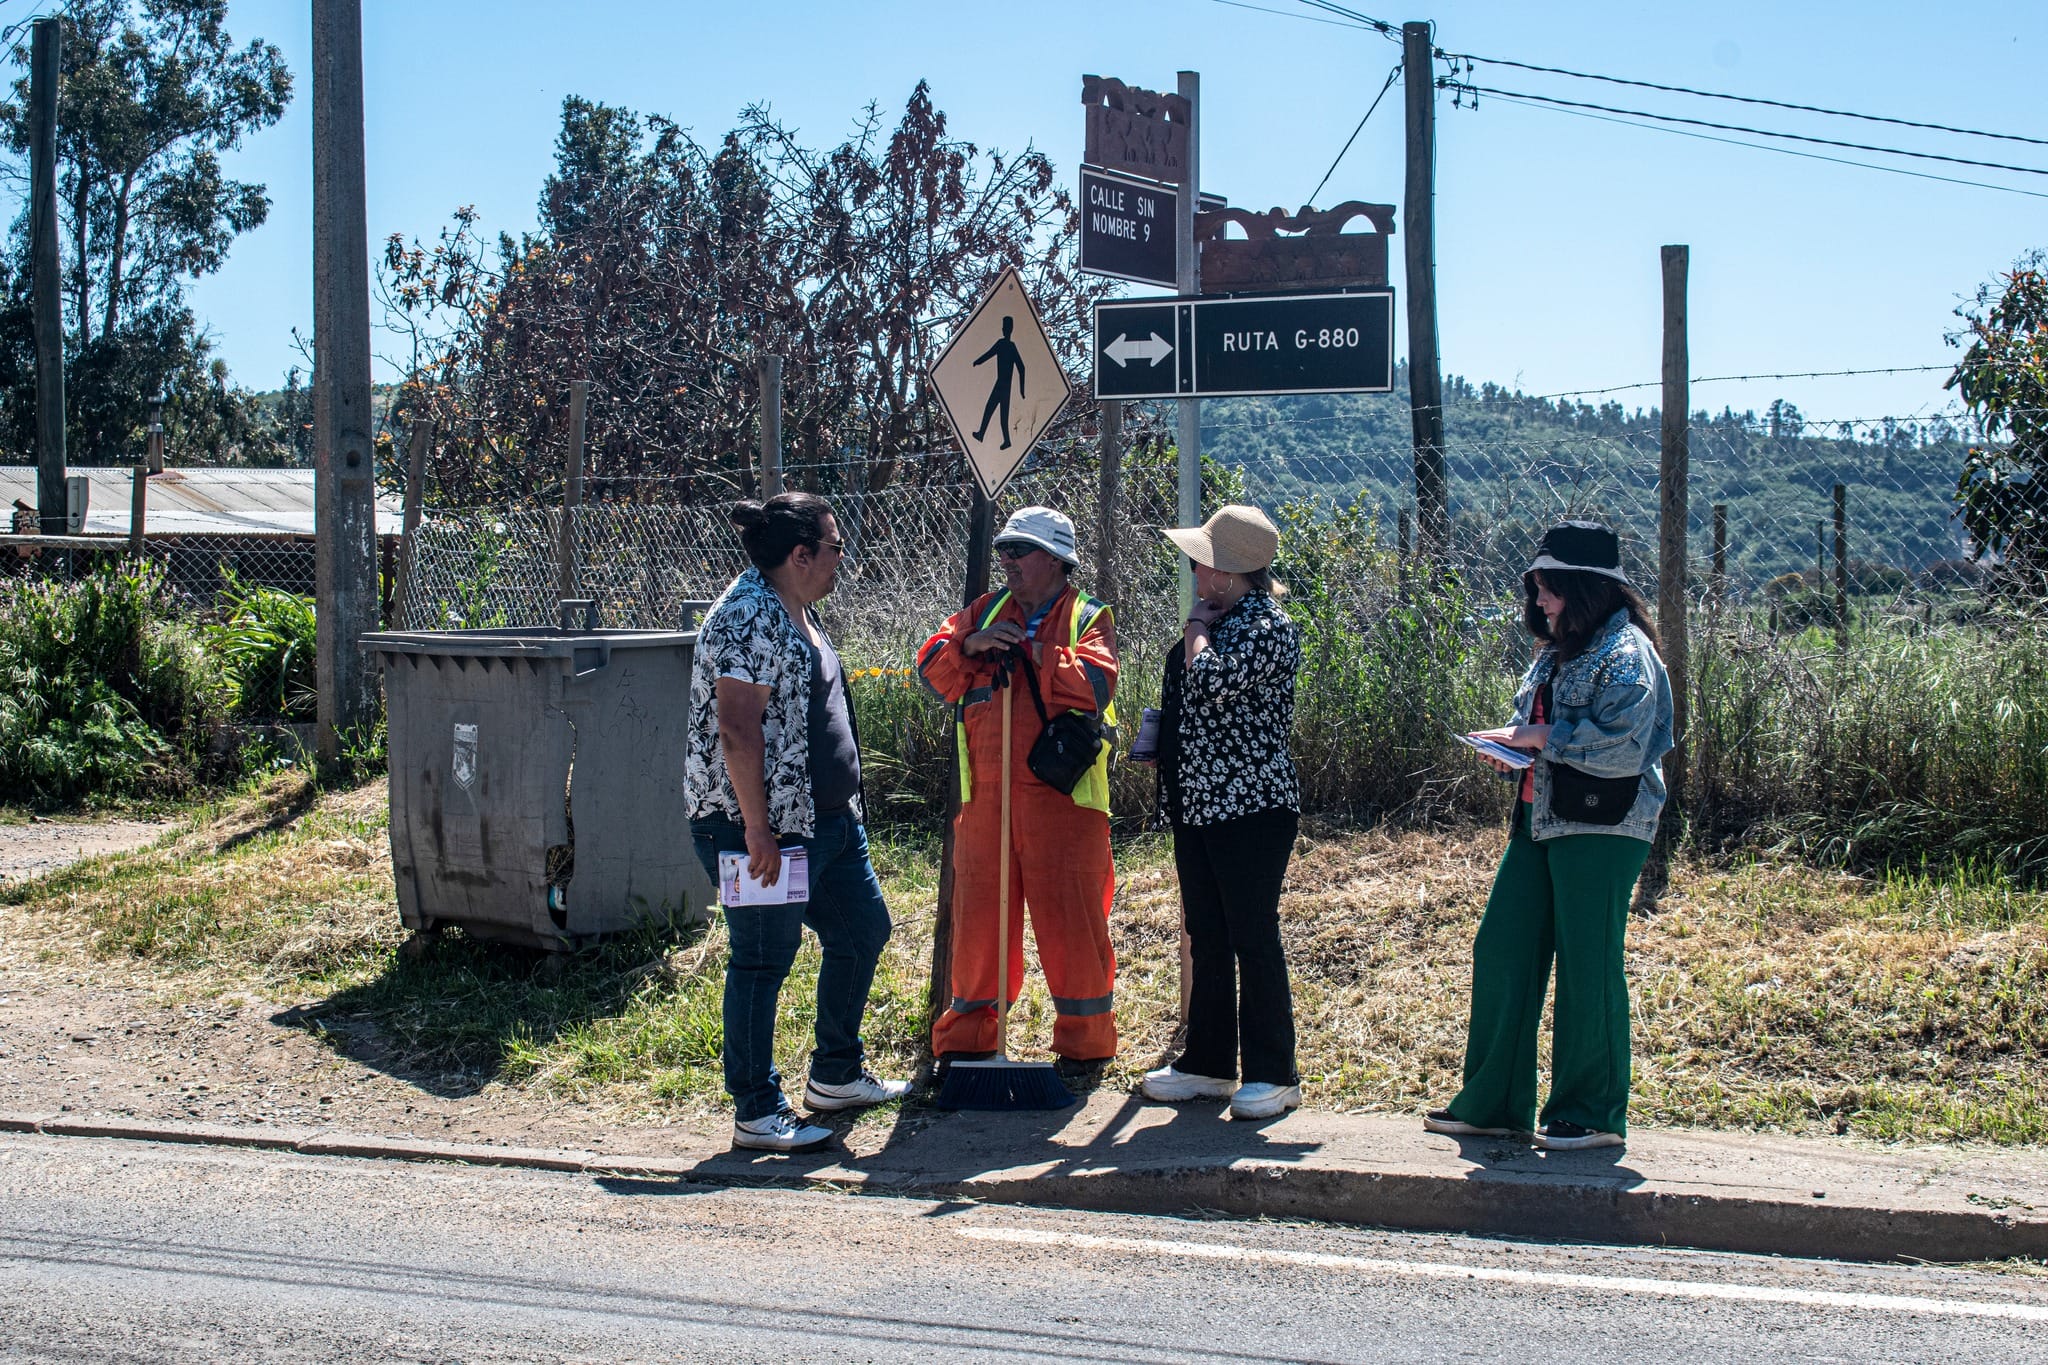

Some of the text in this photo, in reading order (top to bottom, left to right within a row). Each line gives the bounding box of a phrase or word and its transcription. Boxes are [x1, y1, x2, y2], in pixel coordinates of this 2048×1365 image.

[1091, 185, 1154, 218] CALLE SIN
[1093, 212, 1150, 242] NOMBRE 9
[1223, 327, 1359, 352] RUTA G-880
